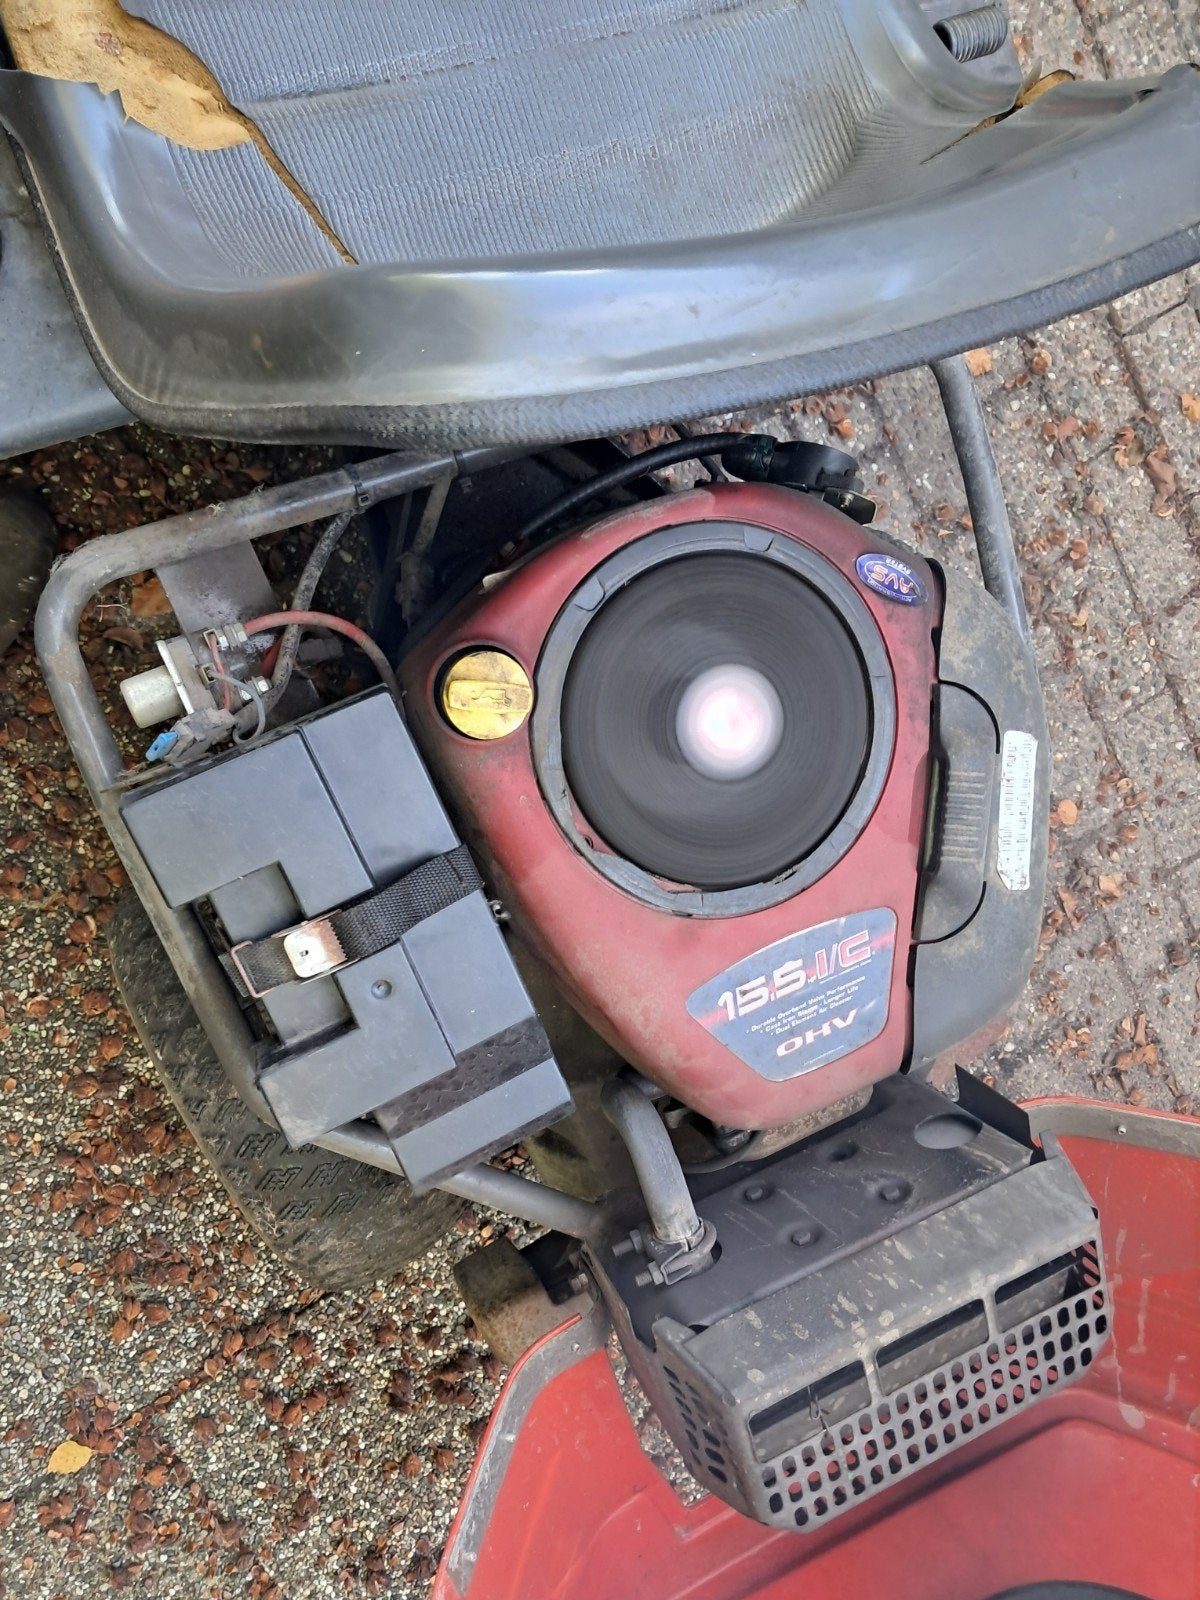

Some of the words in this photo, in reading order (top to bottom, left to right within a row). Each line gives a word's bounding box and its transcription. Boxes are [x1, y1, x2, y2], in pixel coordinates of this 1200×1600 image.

[870, 564, 914, 594] AVS
[717, 958, 807, 1021] 15.5
[815, 929, 871, 980] I/C
[751, 1016, 776, 1031] Durable
[777, 1001, 806, 1019] Overhead
[808, 994, 825, 1004] Valve
[826, 975, 866, 996] Performance
[765, 1021, 781, 1032] Cast
[782, 1014, 796, 1023] Iron
[824, 991, 846, 1005] Longer
[847, 985, 859, 994] Life
[775, 1023, 790, 1034] Dual
[791, 1011, 817, 1026] Element
[819, 1006, 828, 1014] Air
[829, 995, 853, 1009] Cleaner
[776, 1007, 858, 1057] OHV
